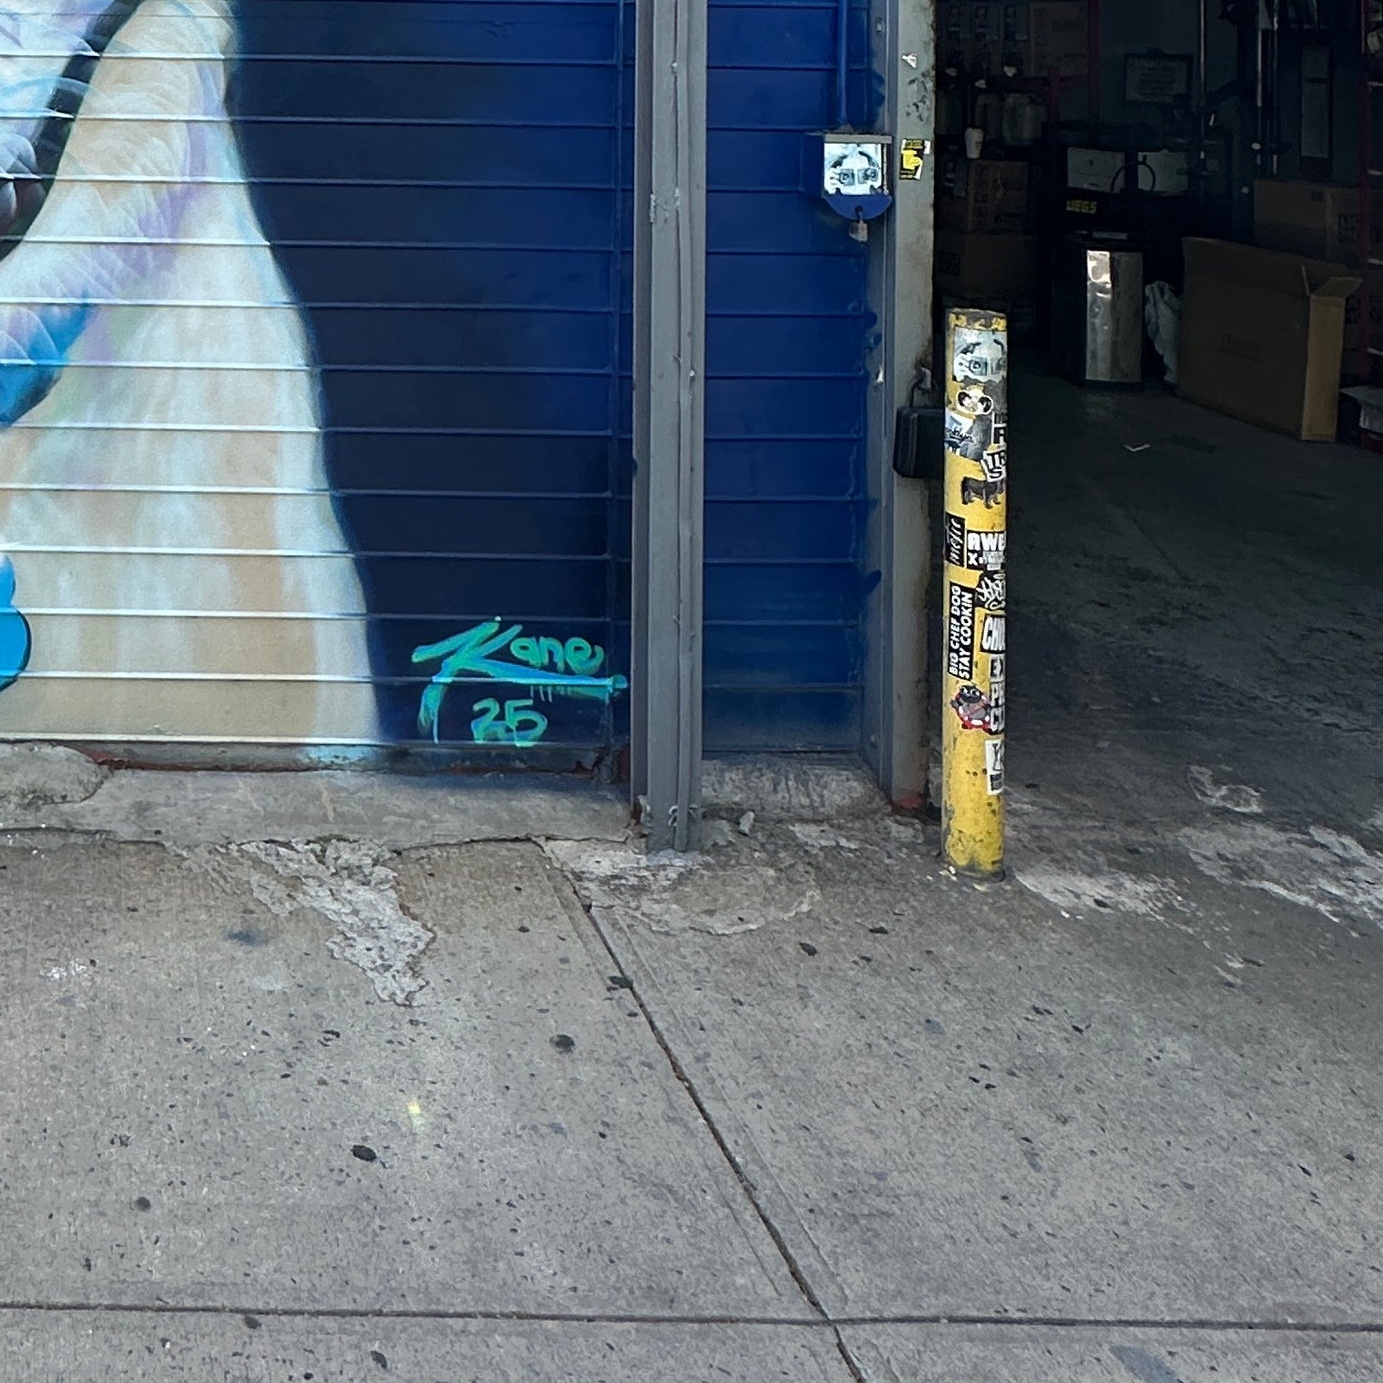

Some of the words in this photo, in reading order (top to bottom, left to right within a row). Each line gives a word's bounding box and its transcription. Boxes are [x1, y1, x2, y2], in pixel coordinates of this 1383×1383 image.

[951, 585, 961, 616] DOG
[950, 618, 960, 650] CHEF
[960, 591, 973, 646] COOKIN
[948, 652, 958, 676] BIG
[958, 647, 971, 679] STAY
[471, 697, 548, 747] 25
